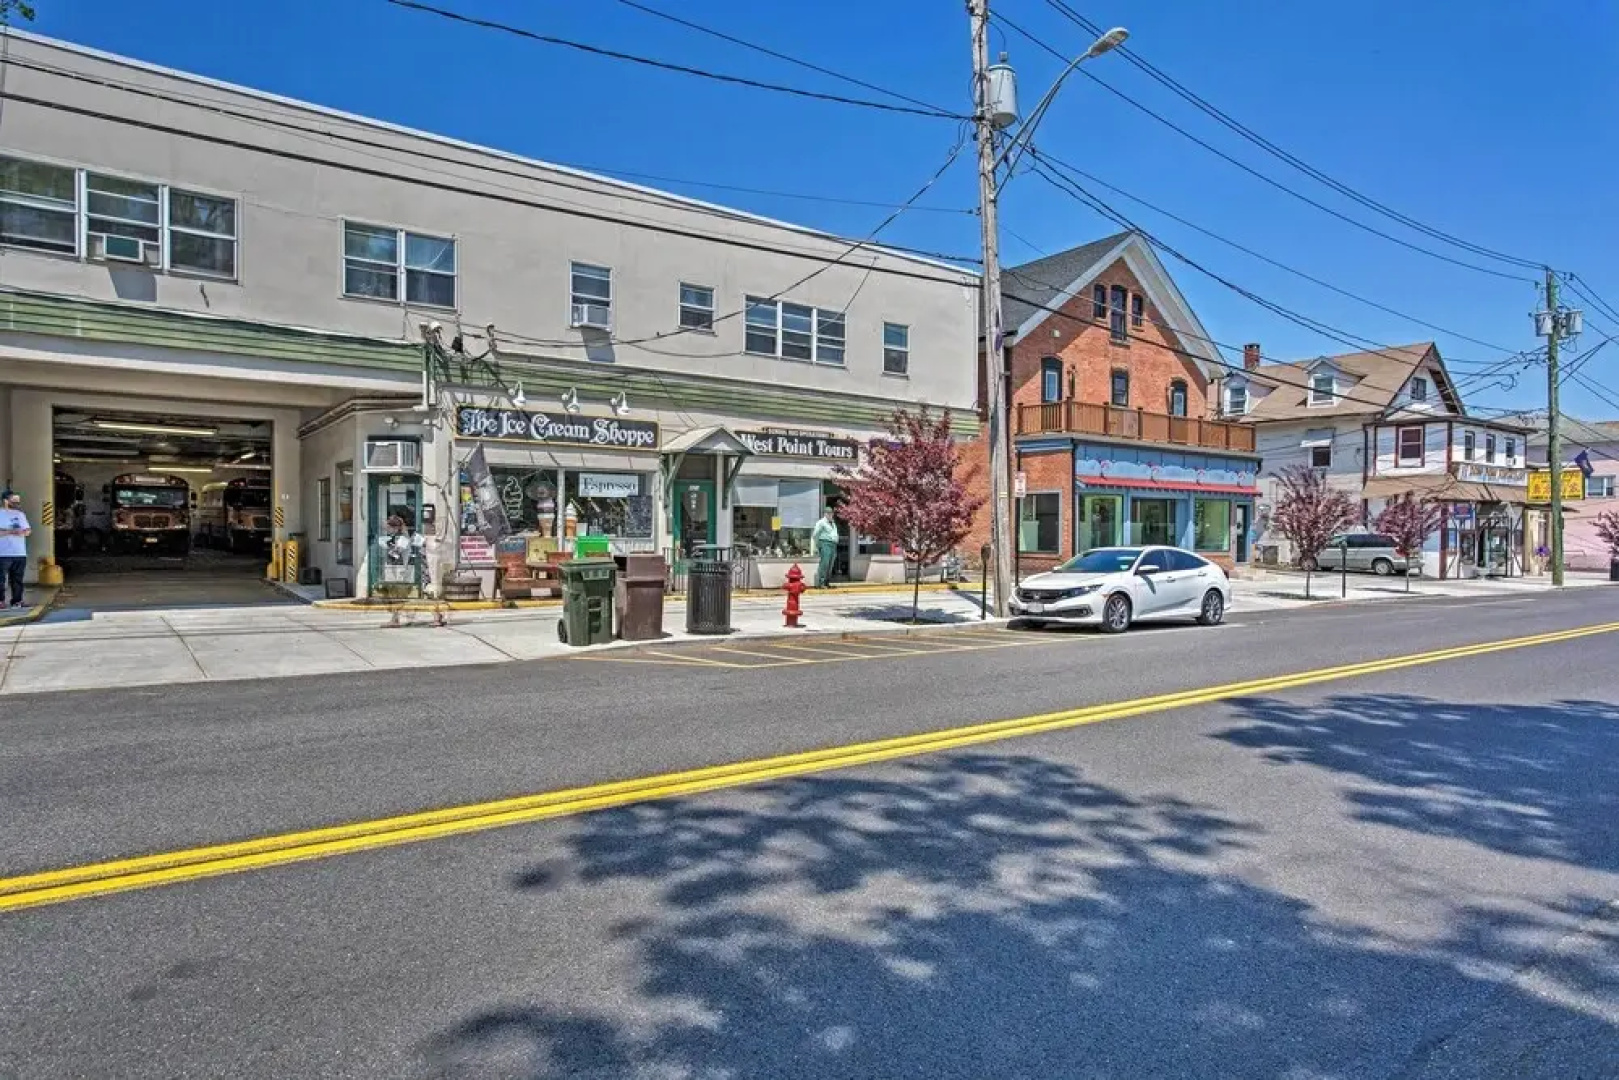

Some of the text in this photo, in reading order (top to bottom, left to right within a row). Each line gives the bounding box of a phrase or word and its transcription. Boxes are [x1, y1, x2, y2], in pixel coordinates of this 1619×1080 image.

[460, 409, 655, 446] The Ice Cream Shoppe
[740, 433, 774, 454] West
[777, 436, 814, 456] Point
[816, 439, 854, 458] Tours
[583, 477, 636, 493] Espresso
